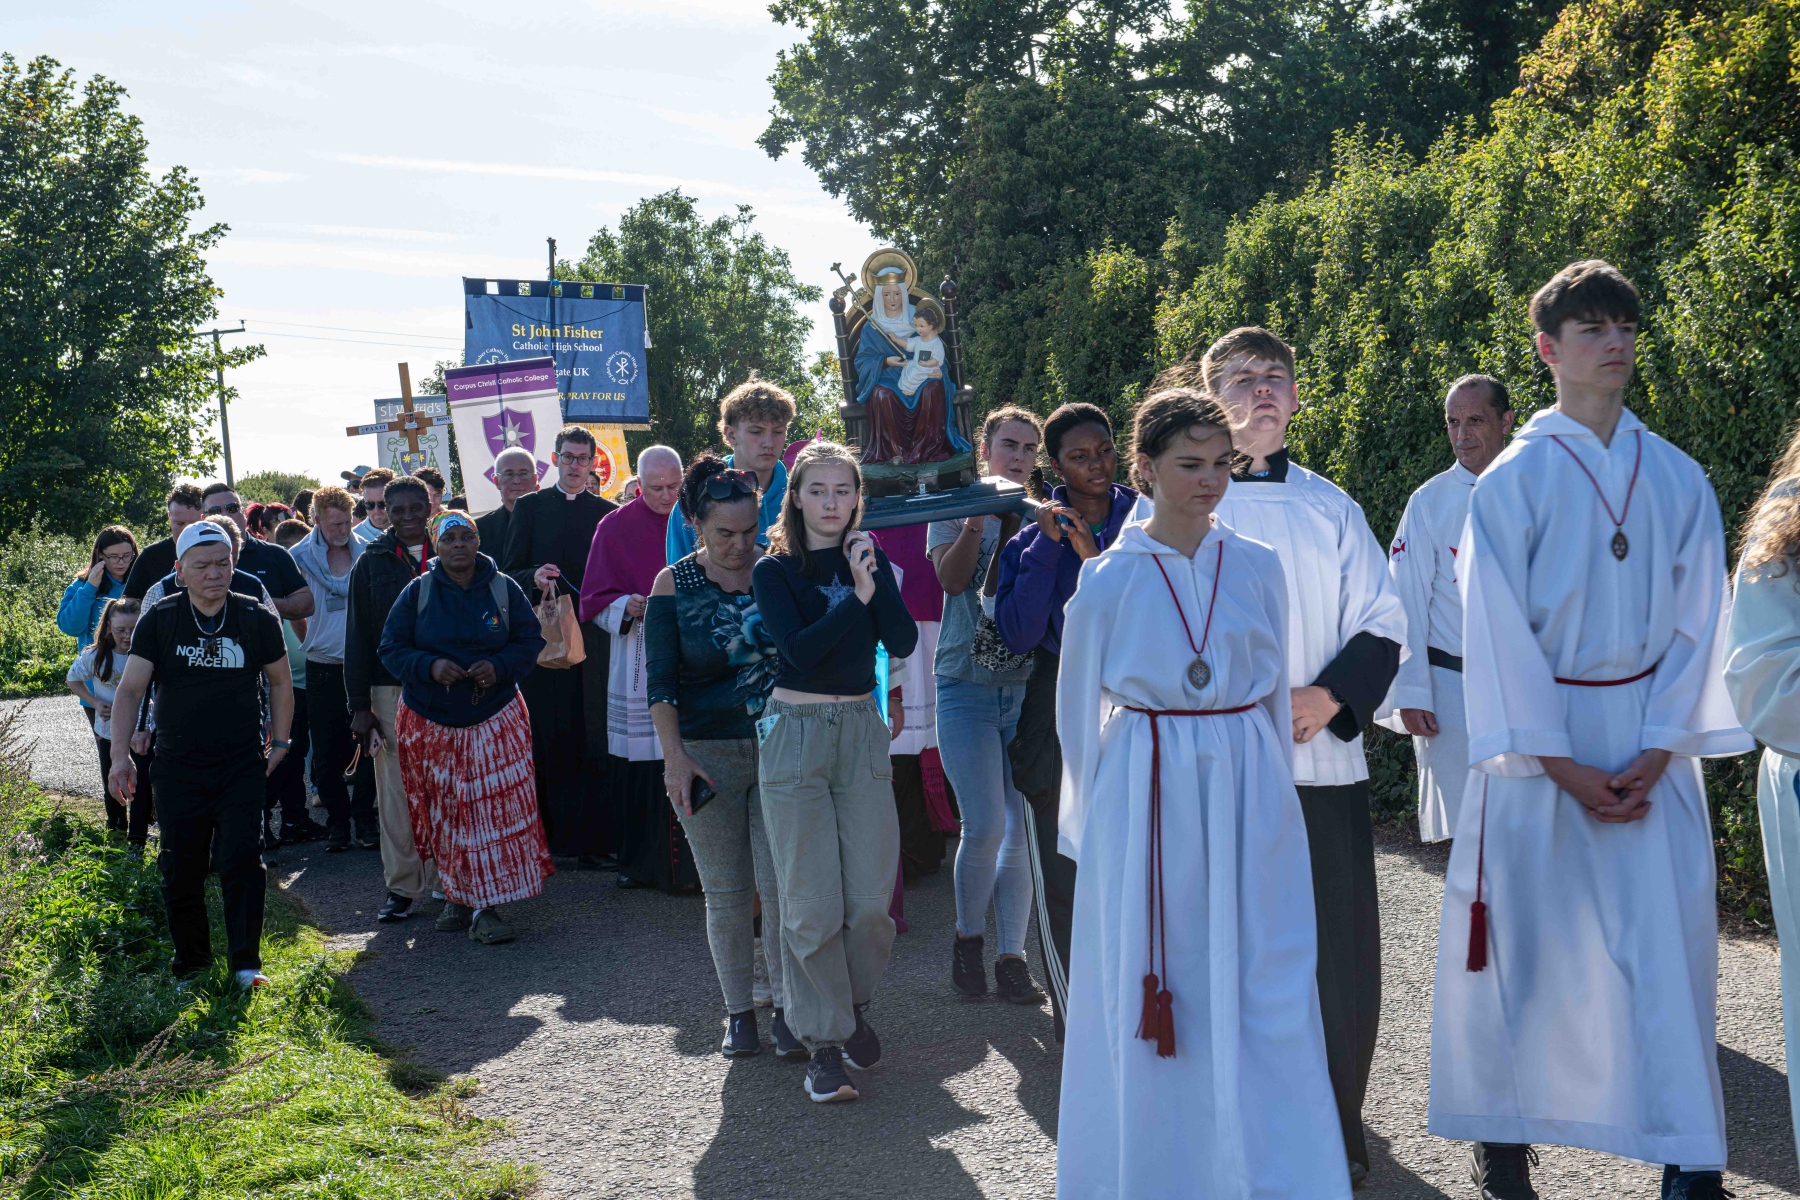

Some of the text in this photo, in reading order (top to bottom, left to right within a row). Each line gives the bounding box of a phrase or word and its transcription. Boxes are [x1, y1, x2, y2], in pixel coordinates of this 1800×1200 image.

[512, 324, 604, 340] St John Fisher
[512, 341, 603, 354] Catholic High School
[554, 366, 590, 378] gate, UK
[453, 374, 549, 391] Corpus Christi Catholic College
[567, 391, 591, 401] PRAY
[591, 392, 612, 401] FOR
[613, 392, 626, 401] US
[396, 402, 442, 416] Wfrid's
[197, 637, 222, 648] TE
[175, 644, 222, 658] NORH
[187, 656, 222, 668] FACE
